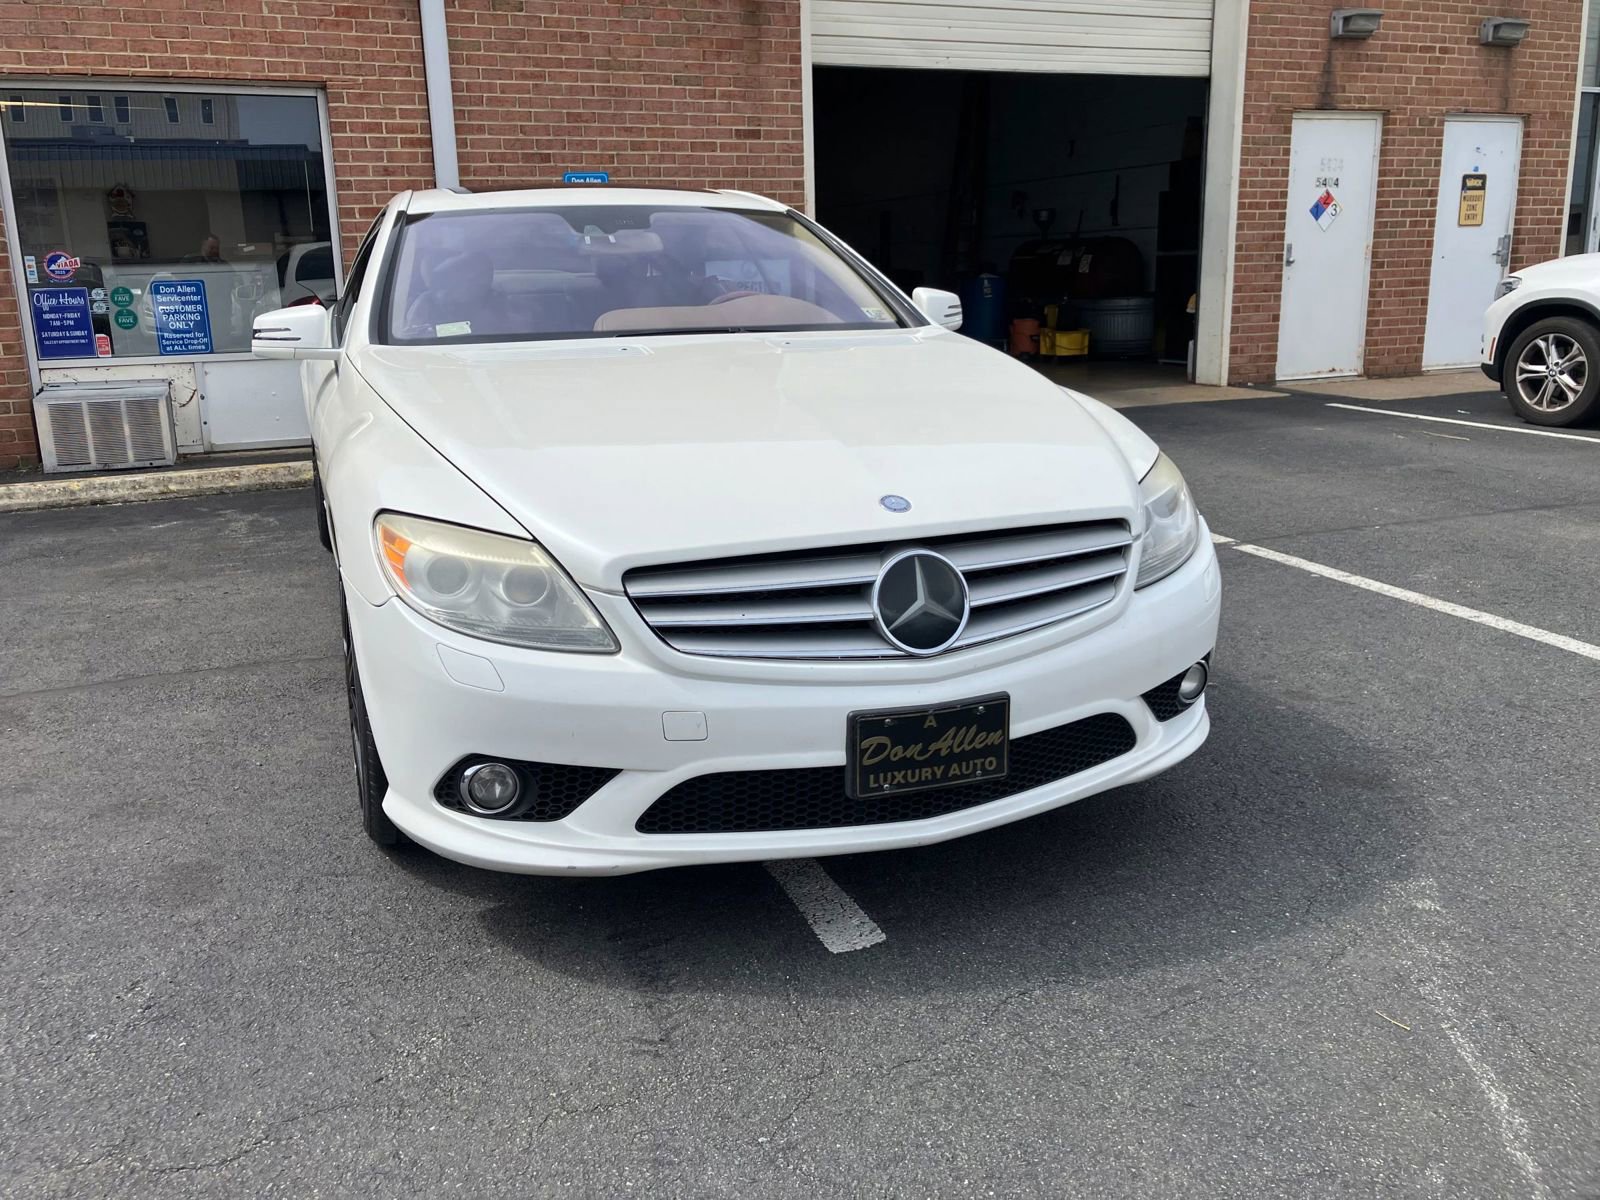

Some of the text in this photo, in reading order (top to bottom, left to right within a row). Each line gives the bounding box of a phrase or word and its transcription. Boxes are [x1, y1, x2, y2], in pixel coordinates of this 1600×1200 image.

[1315, 177, 1339, 188] 5404
[1330, 203, 1338, 217] 3
[177, 285, 196, 293] Allen
[33, 292, 85, 311] Office Hours
[157, 294, 202, 302] Servicenter
[159, 304, 203, 313] CUSTOMER
[162, 313, 201, 321] PARKING
[168, 321, 195, 329] ONLY
[923, 715, 937, 729] A
[860, 724, 1004, 766] Don Allen
[869, 756, 997, 788] LUXURY AUTO
